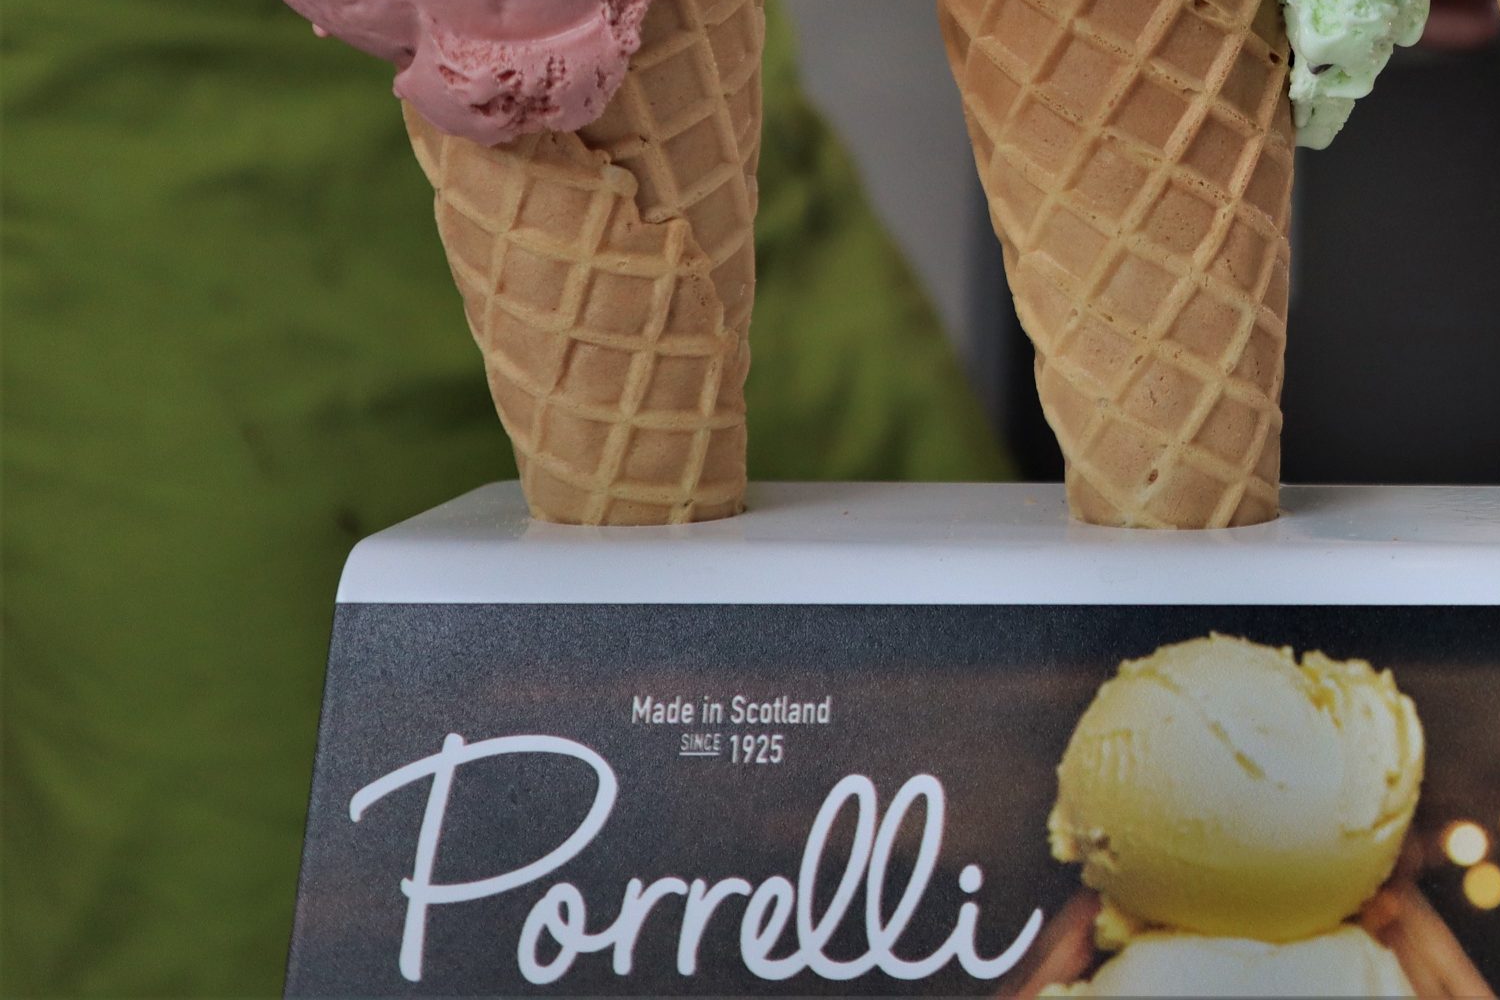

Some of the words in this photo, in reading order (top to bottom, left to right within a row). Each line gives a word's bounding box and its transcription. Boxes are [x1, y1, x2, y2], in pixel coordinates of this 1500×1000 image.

[631, 696, 694, 724] Made
[702, 696, 723, 724] in
[730, 696, 831, 724] Scotland
[680, 734, 721, 753] SINCE
[729, 734, 784, 763] 1925
[349, 733, 1043, 985] Porrelli
